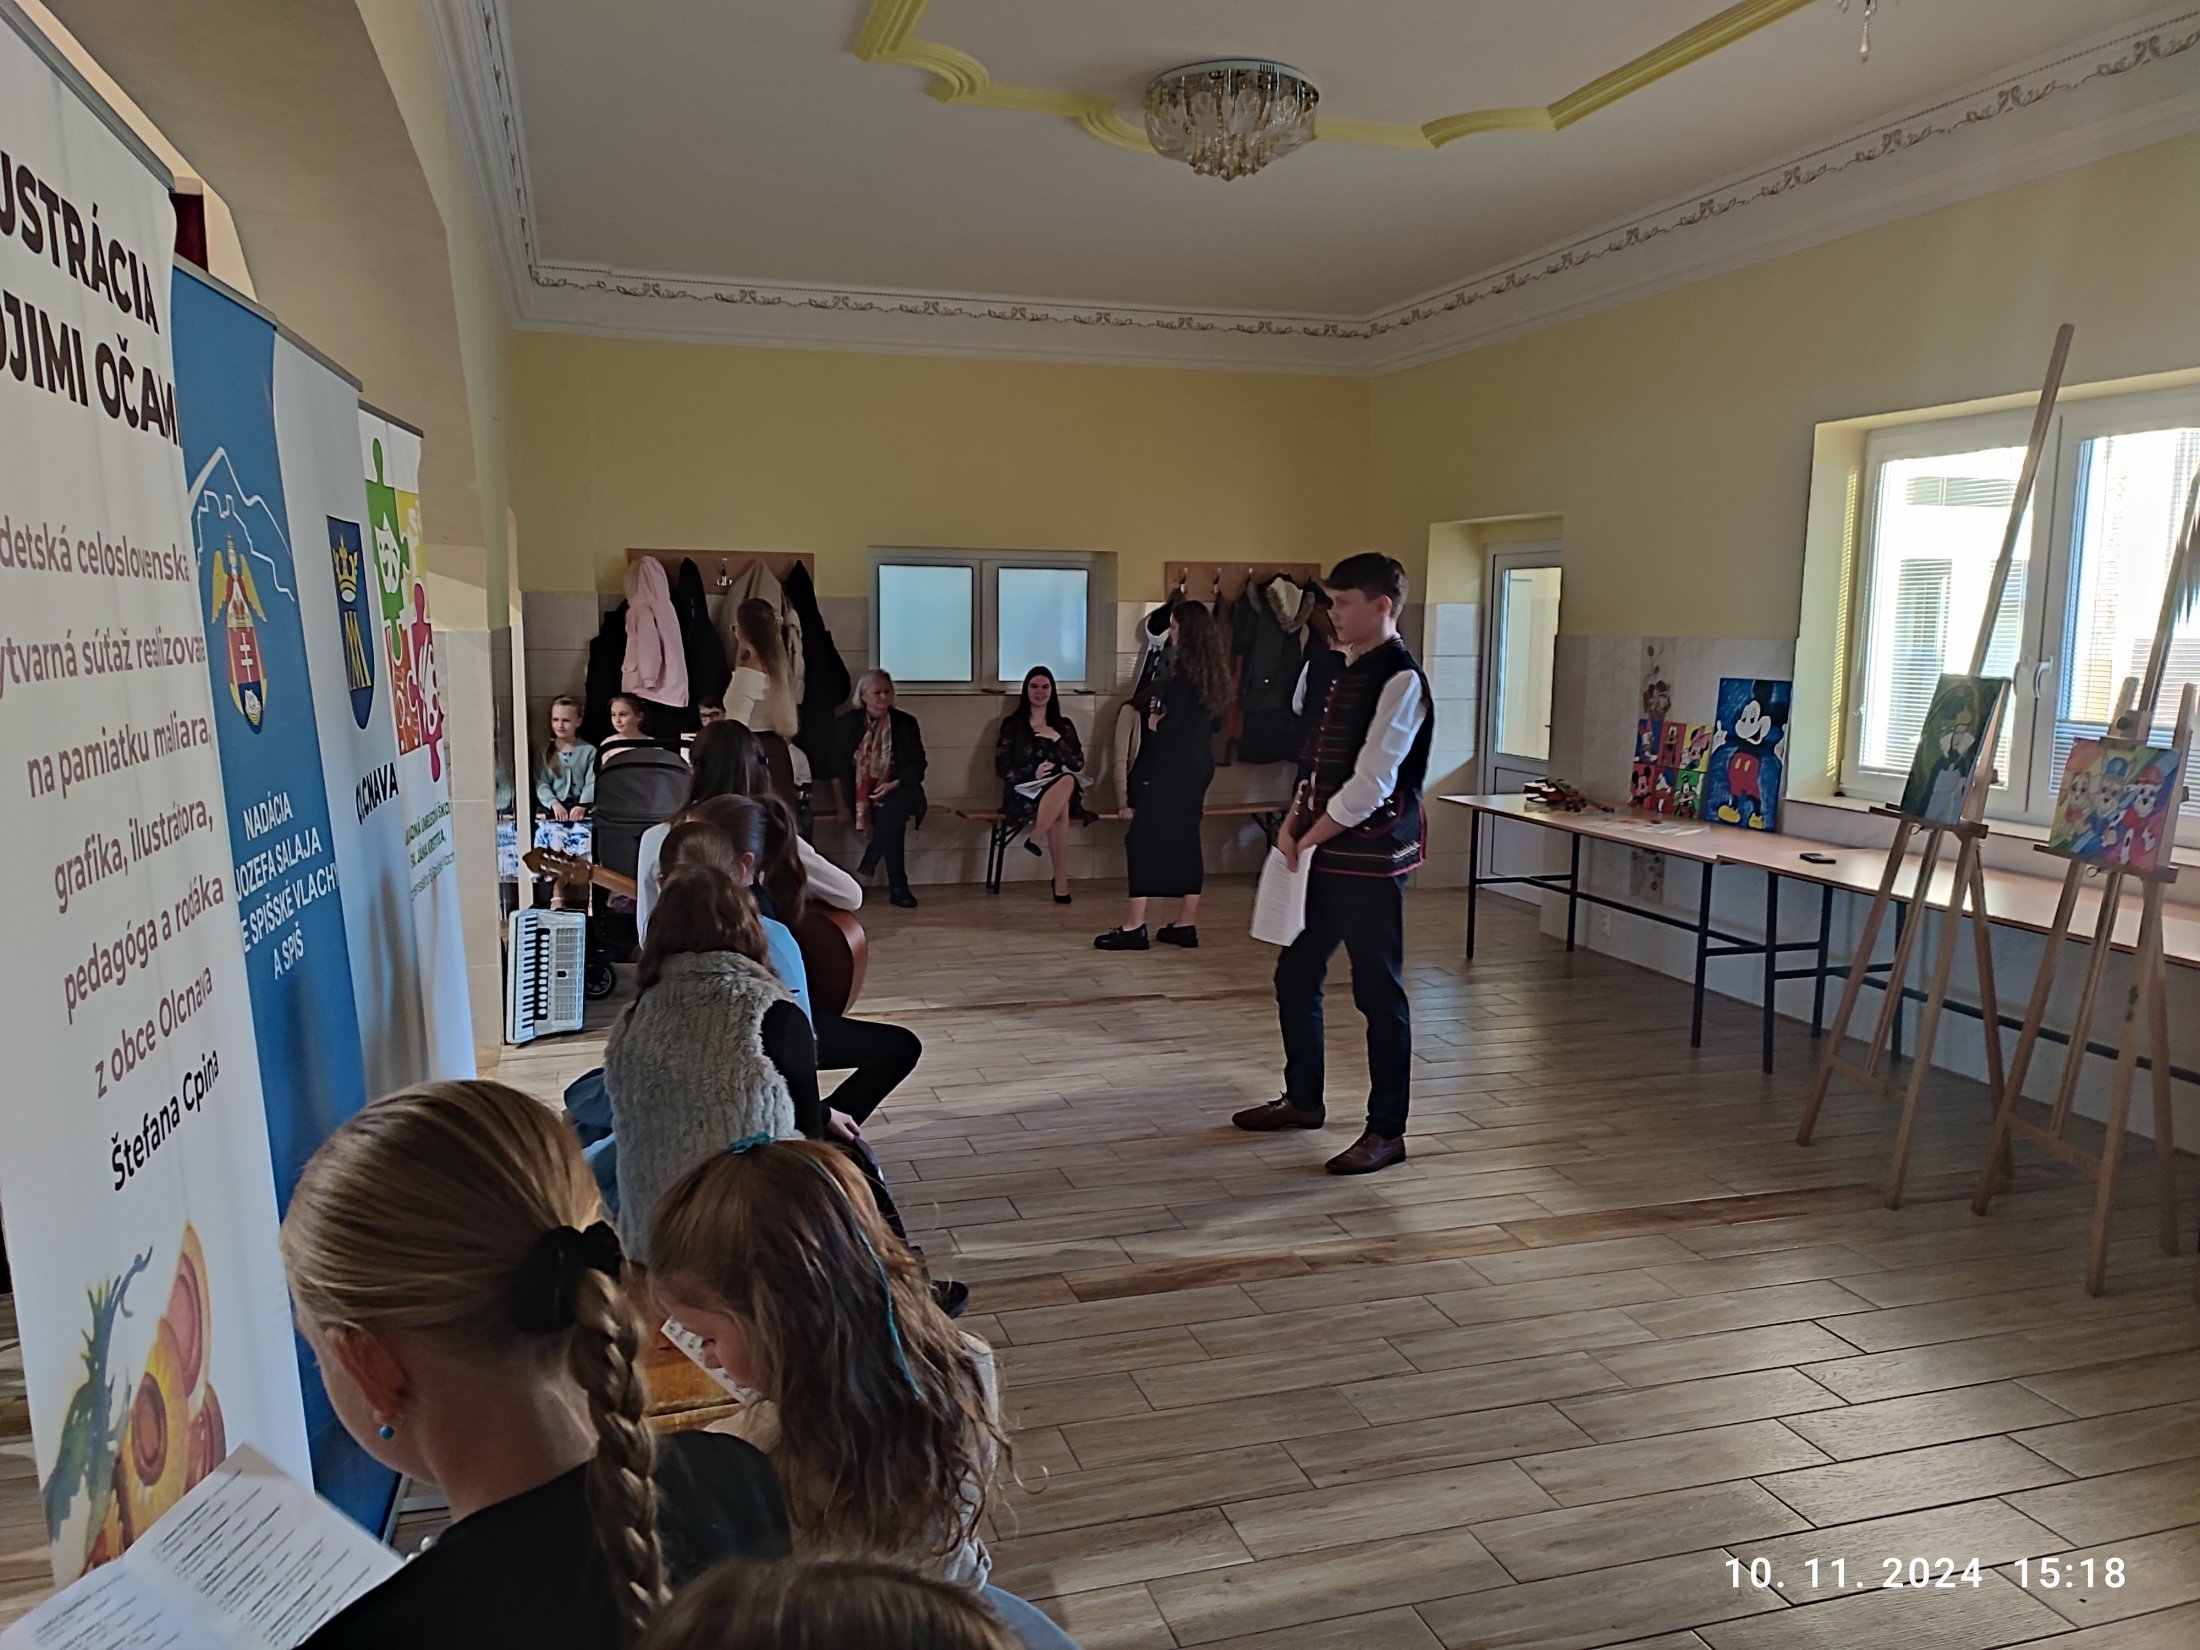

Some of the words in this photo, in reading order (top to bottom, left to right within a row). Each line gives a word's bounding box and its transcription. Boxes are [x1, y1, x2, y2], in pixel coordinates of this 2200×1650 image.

[0, 288, 89, 408] JIMI
[0, 515, 72, 574] detská
[84, 627, 133, 675] súťaž
[27, 754, 55, 798] na
[58, 724, 150, 799] pamiatku
[154, 710, 212, 759] maliara,
[54, 832, 129, 914] grafika,
[130, 799, 213, 863] ilustrátora,
[243, 791, 293, 841] NADÁCIA
[235, 849, 277, 902] JOZEFA
[275, 827, 322, 874] SALAJA
[64, 920, 158, 1025] pedagóga
[161, 909, 172, 941] a
[174, 874, 224, 933] rodáka
[250, 879, 294, 945] SPIŠSKÉ
[273, 948, 283, 980] A
[282, 920, 304, 972] SPIŠ
[94, 1060, 107, 1099] z
[111, 1019, 156, 1082] obce
[159, 966, 213, 1038] Olcnava
[111, 1095, 181, 1192] Štefana
[182, 1050, 219, 1112] Cpina
